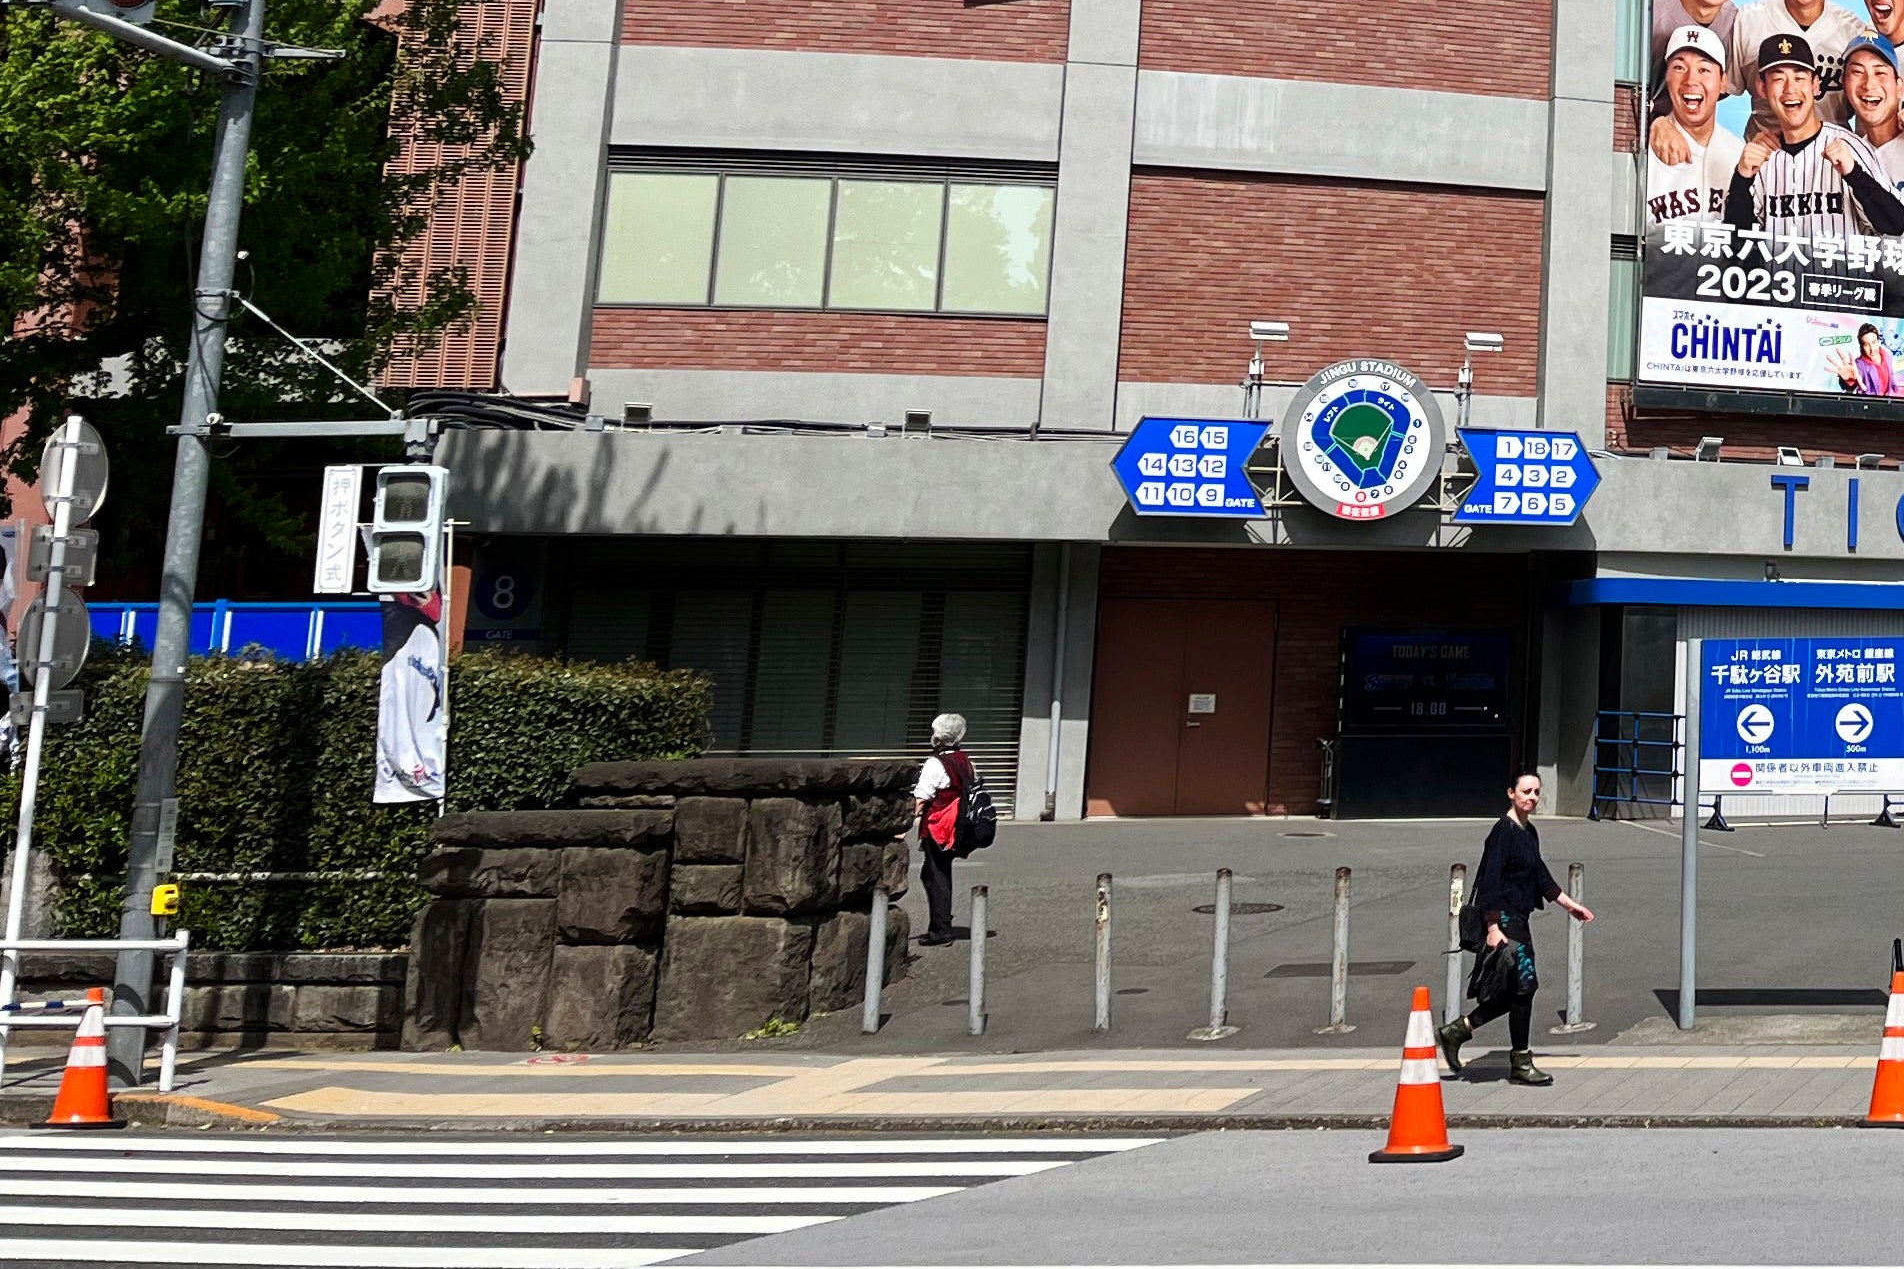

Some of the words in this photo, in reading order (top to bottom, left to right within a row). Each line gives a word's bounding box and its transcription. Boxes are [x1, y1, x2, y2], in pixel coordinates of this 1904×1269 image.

[1648, 187, 1724, 224] WASE
[1768, 191, 1844, 219] IKKIO
[1696, 263, 1797, 303] 2023
[1320, 361, 1357, 385] JINGU
[1359, 360, 1417, 388] STADIUM
[1175, 430, 1195, 444] 16
[1206, 431, 1225, 445] 15
[1527, 441, 1546, 455] 18
[1554, 442, 1573, 456] 17
[1143, 457, 1164, 472] 14
[1174, 458, 1194, 472] 13
[1204, 459, 1224, 473] 12
[1143, 486, 1159, 500] 11
[1172, 487, 1192, 501] 10
[1225, 498, 1255, 508] GATE
[1464, 504, 1493, 514] GATE
[324, 477, 351, 582] 押ボタン式
[492, 575, 514, 609] 8
[486, 630, 512, 640] GATE
[1392, 645, 1438, 659] TODAY'S
[1440, 645, 1470, 659] GAME
[1731, 649, 1748, 661] JR
[1815, 663, 1895, 684] 外苑前駅
[1410, 701, 1447, 716] 18:00
[1755, 762, 1879, 774] 関係者以外車両進入禁止
